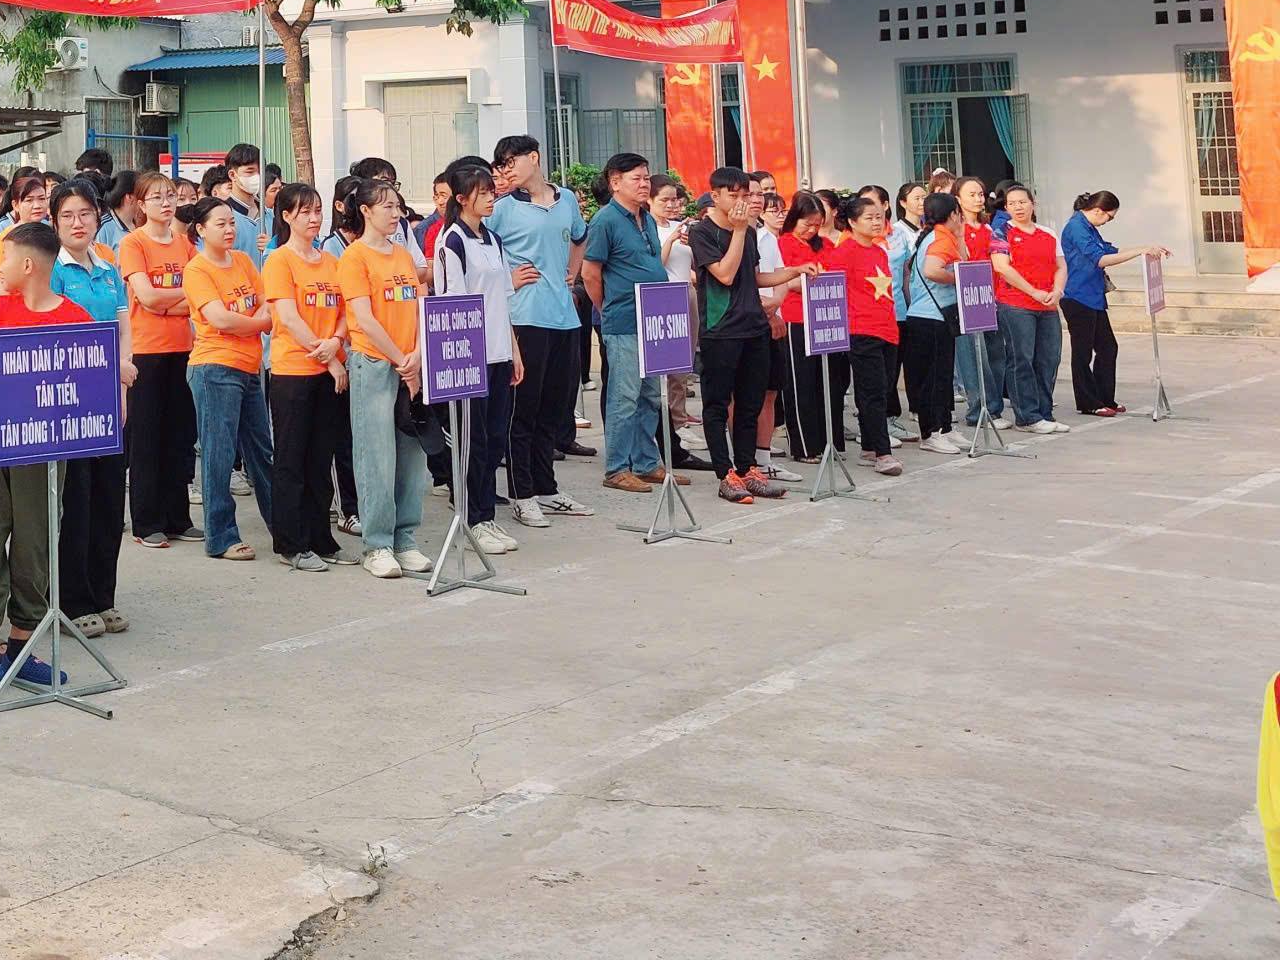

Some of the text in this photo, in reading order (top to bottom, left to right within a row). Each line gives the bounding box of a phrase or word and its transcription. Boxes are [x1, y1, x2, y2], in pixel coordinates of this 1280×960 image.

[164, 263, 181, 272] BE
[233, 285, 249, 297] BE
[316, 282, 333, 291] BE
[393, 275, 409, 285] BE
[963, 282, 979, 306] GIÁO
[645, 314, 688, 346] HỌC SINH
[3, 340, 108, 375] NHÂN DÂN ẤP TÂN HÒA,
[454, 368, 465, 388] LAO
[36, 375, 80, 408] TÂN TIẾN,
[1, 411, 113, 448] TÂN ĐÔNG 1, TÂN ĐÔNG 2
